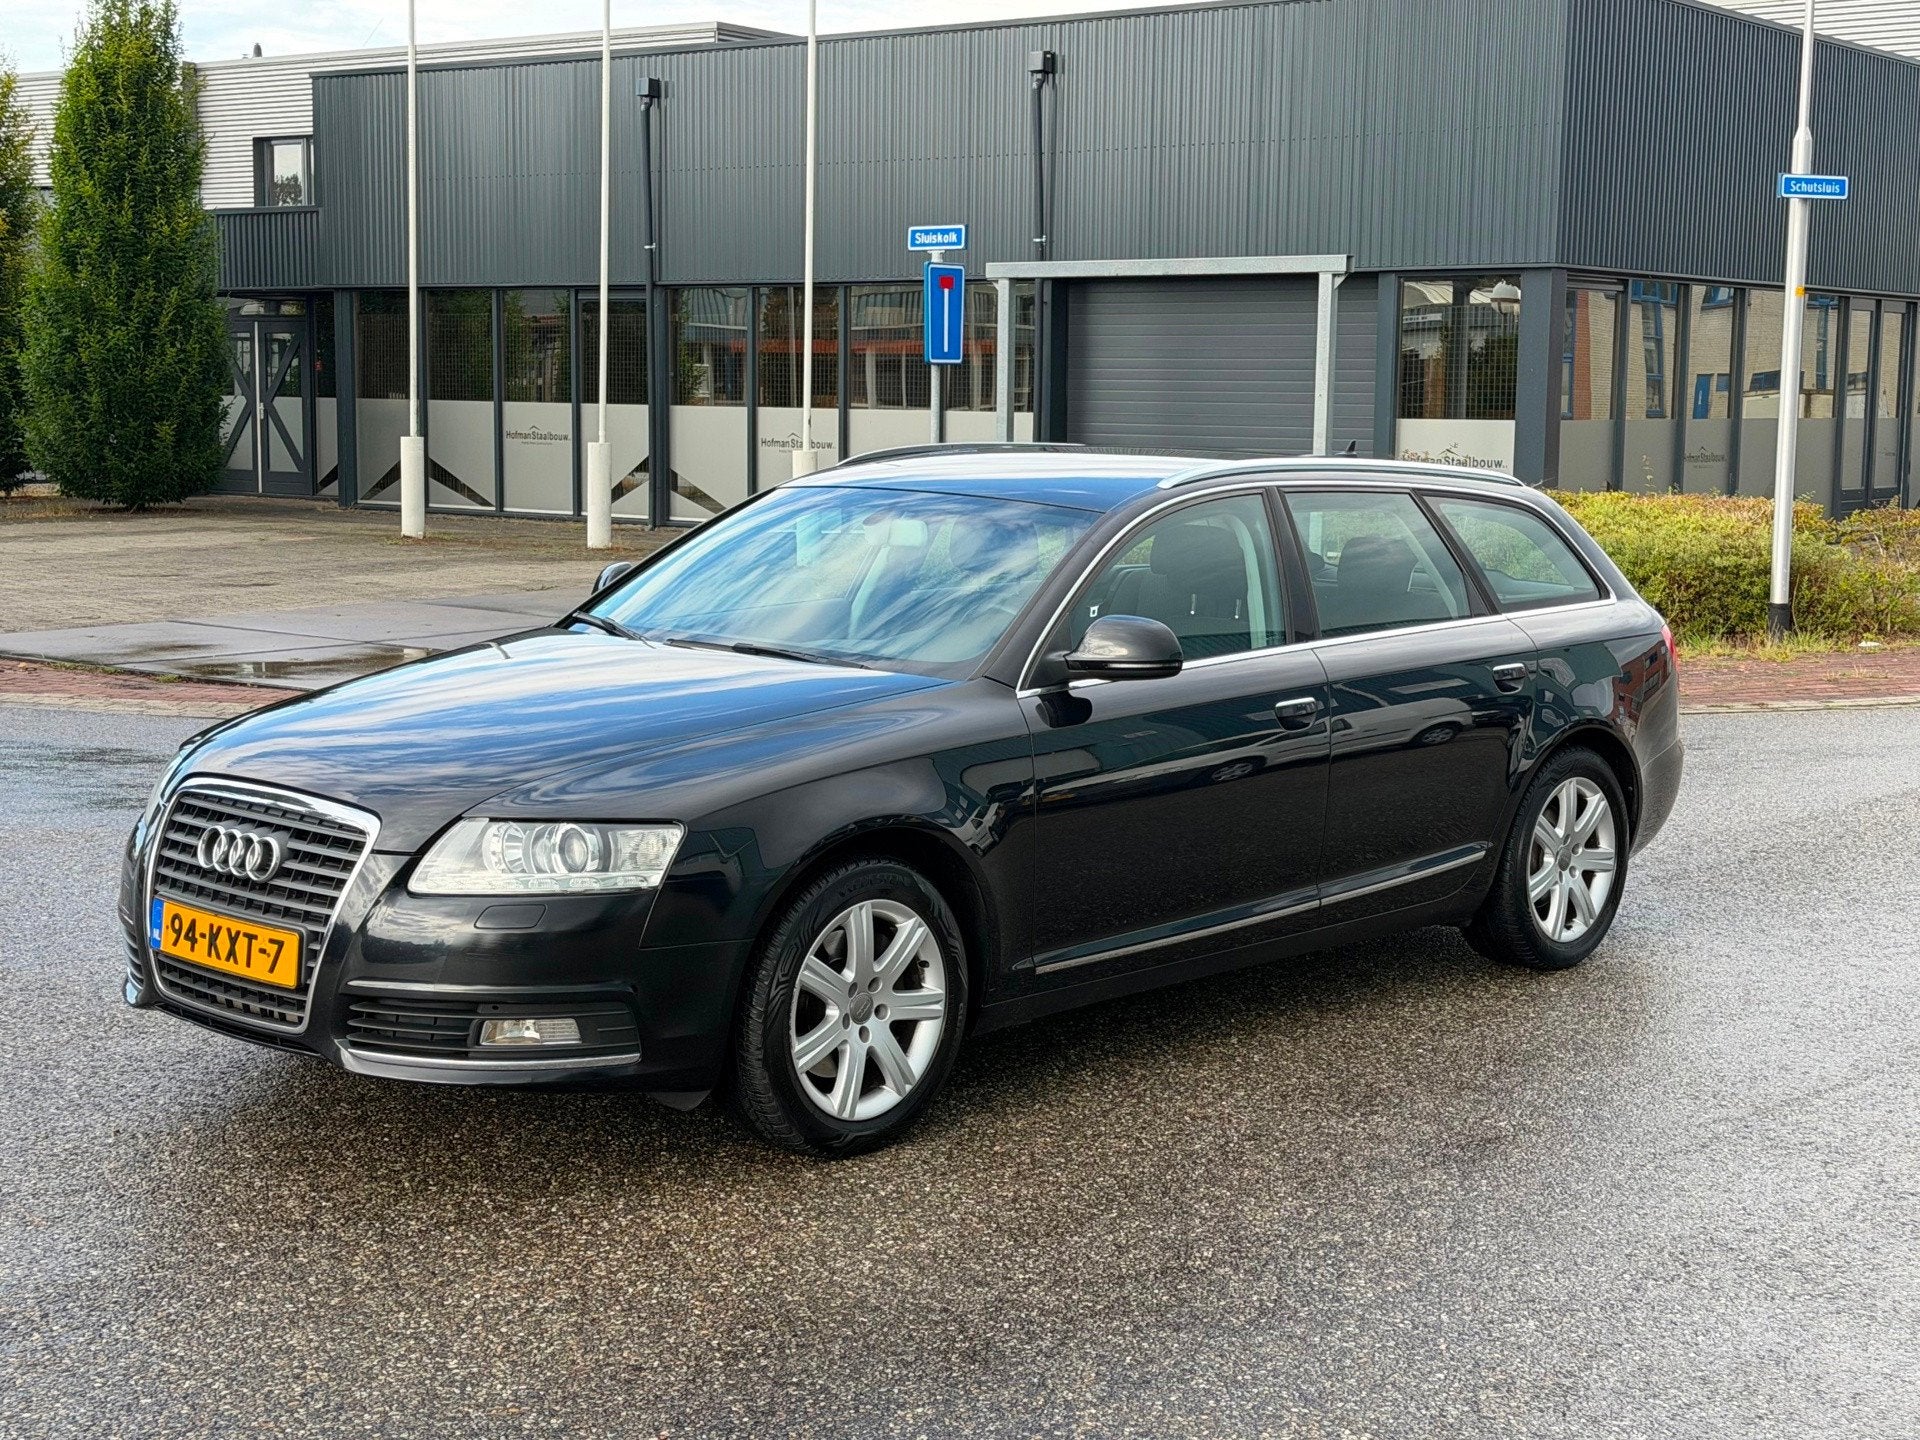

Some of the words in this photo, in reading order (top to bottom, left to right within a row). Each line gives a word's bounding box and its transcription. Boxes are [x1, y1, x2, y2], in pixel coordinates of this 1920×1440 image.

[1789, 180, 1840, 193] Schutsluis
[914, 231, 958, 244] Sluiskolk
[760, 437, 833, 449] HofmanStabouw
[169, 911, 286, 975] 94-KXT-7
